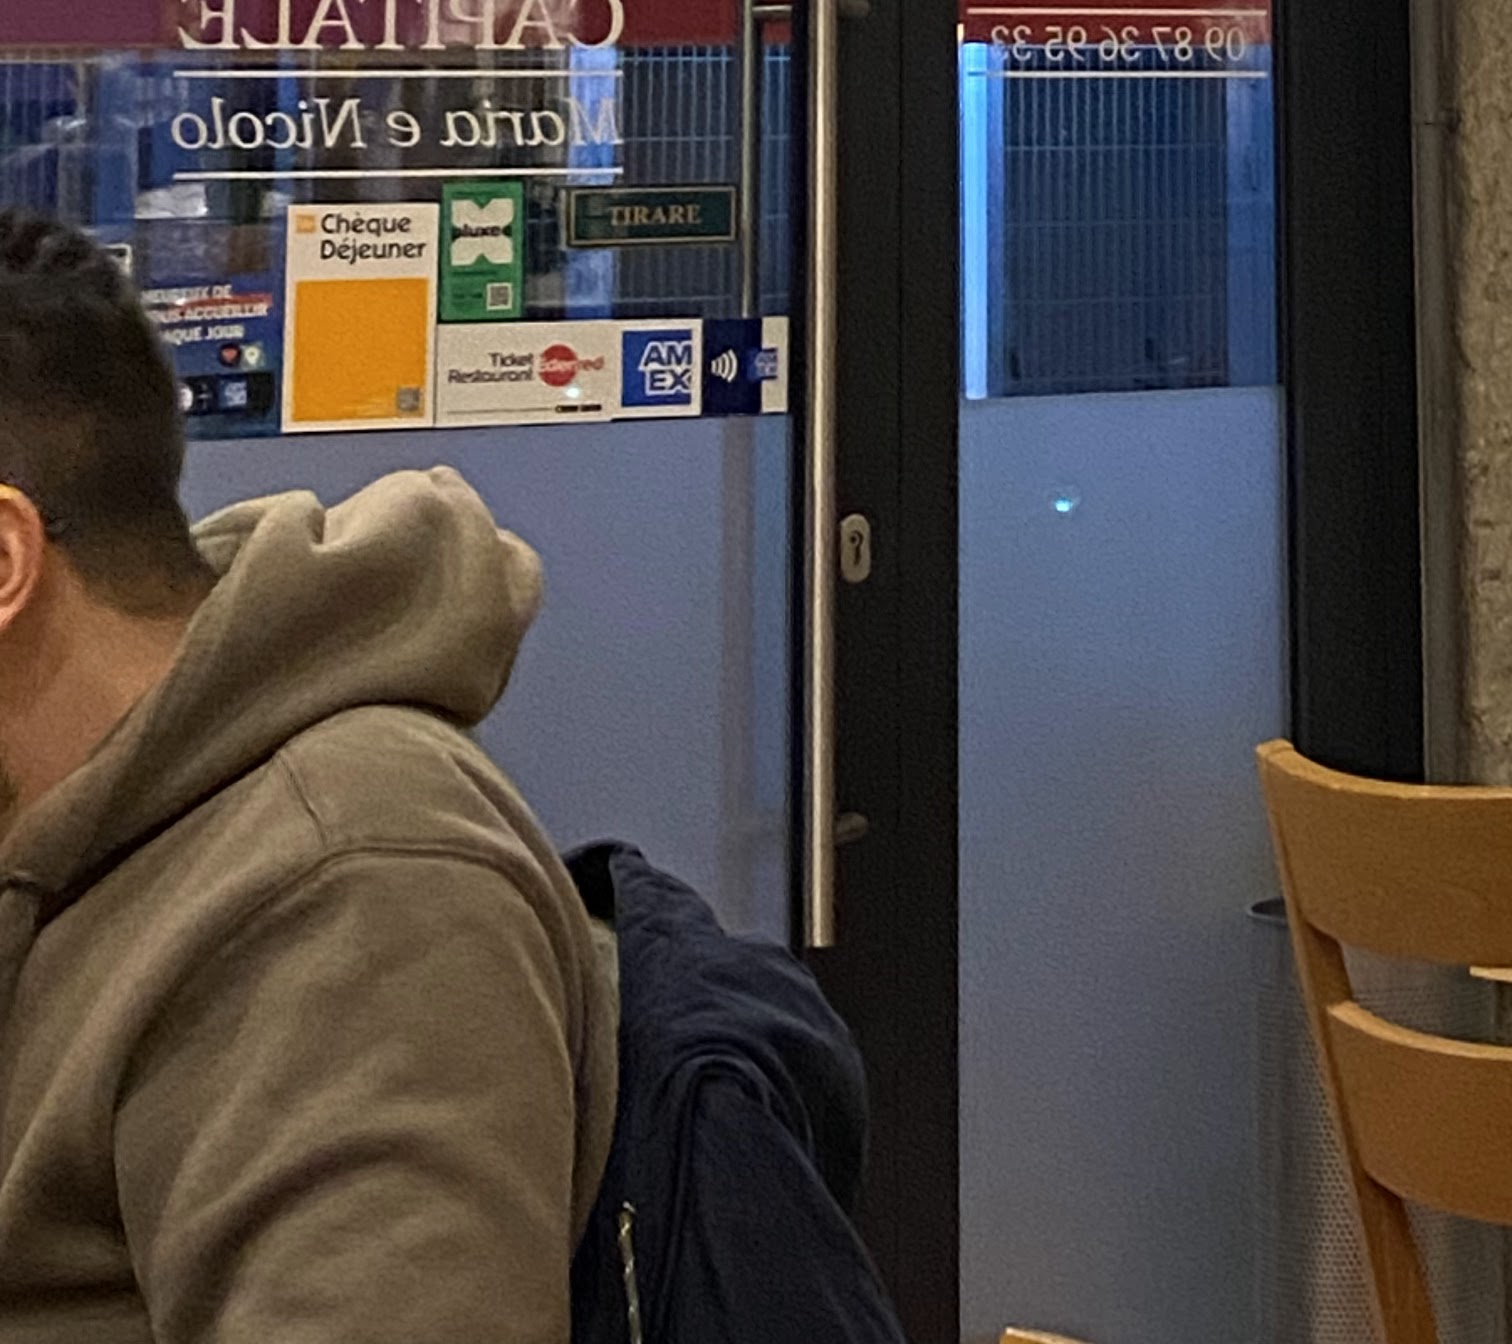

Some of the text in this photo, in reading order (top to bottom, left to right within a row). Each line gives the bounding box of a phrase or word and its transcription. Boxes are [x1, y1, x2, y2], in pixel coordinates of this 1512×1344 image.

[321, 212, 412, 237] Chèque
[608, 205, 701, 226] TIRARE
[320, 237, 427, 265] Déjeuner
[489, 352, 534, 367] Ticket
[641, 341, 692, 367] AM
[645, 368, 692, 395] EX
